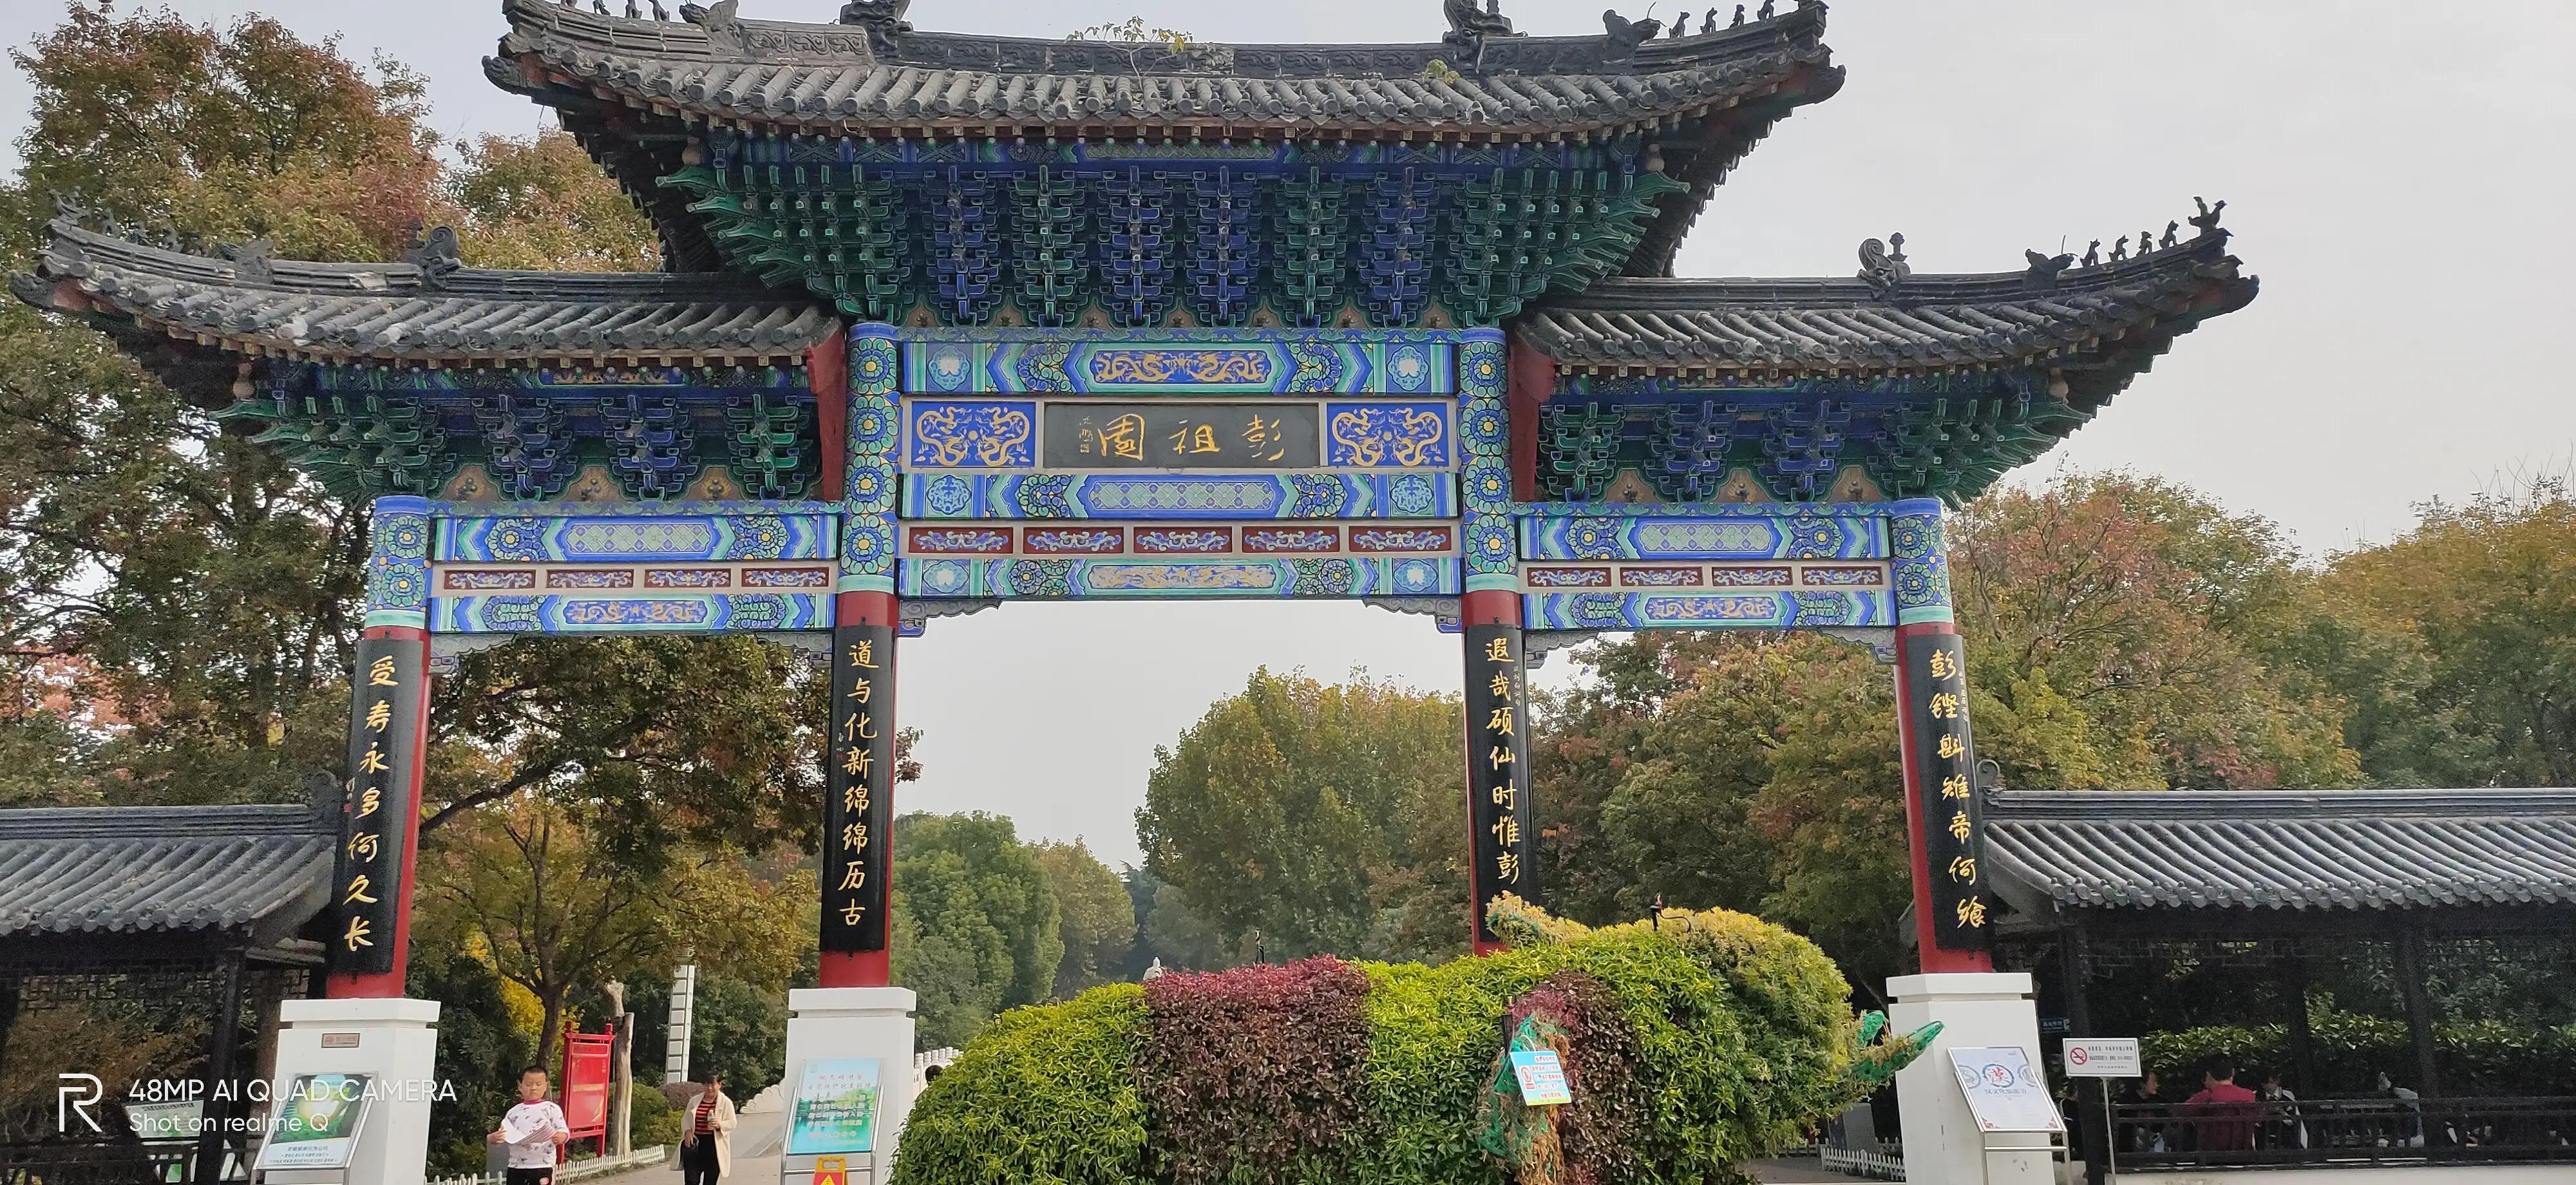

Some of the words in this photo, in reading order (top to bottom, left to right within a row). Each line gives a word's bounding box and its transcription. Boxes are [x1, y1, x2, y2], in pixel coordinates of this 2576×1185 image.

[343, 655, 399, 952] 受寿永多何久长
[838, 640, 880, 927] 道与化新绵绵历古
